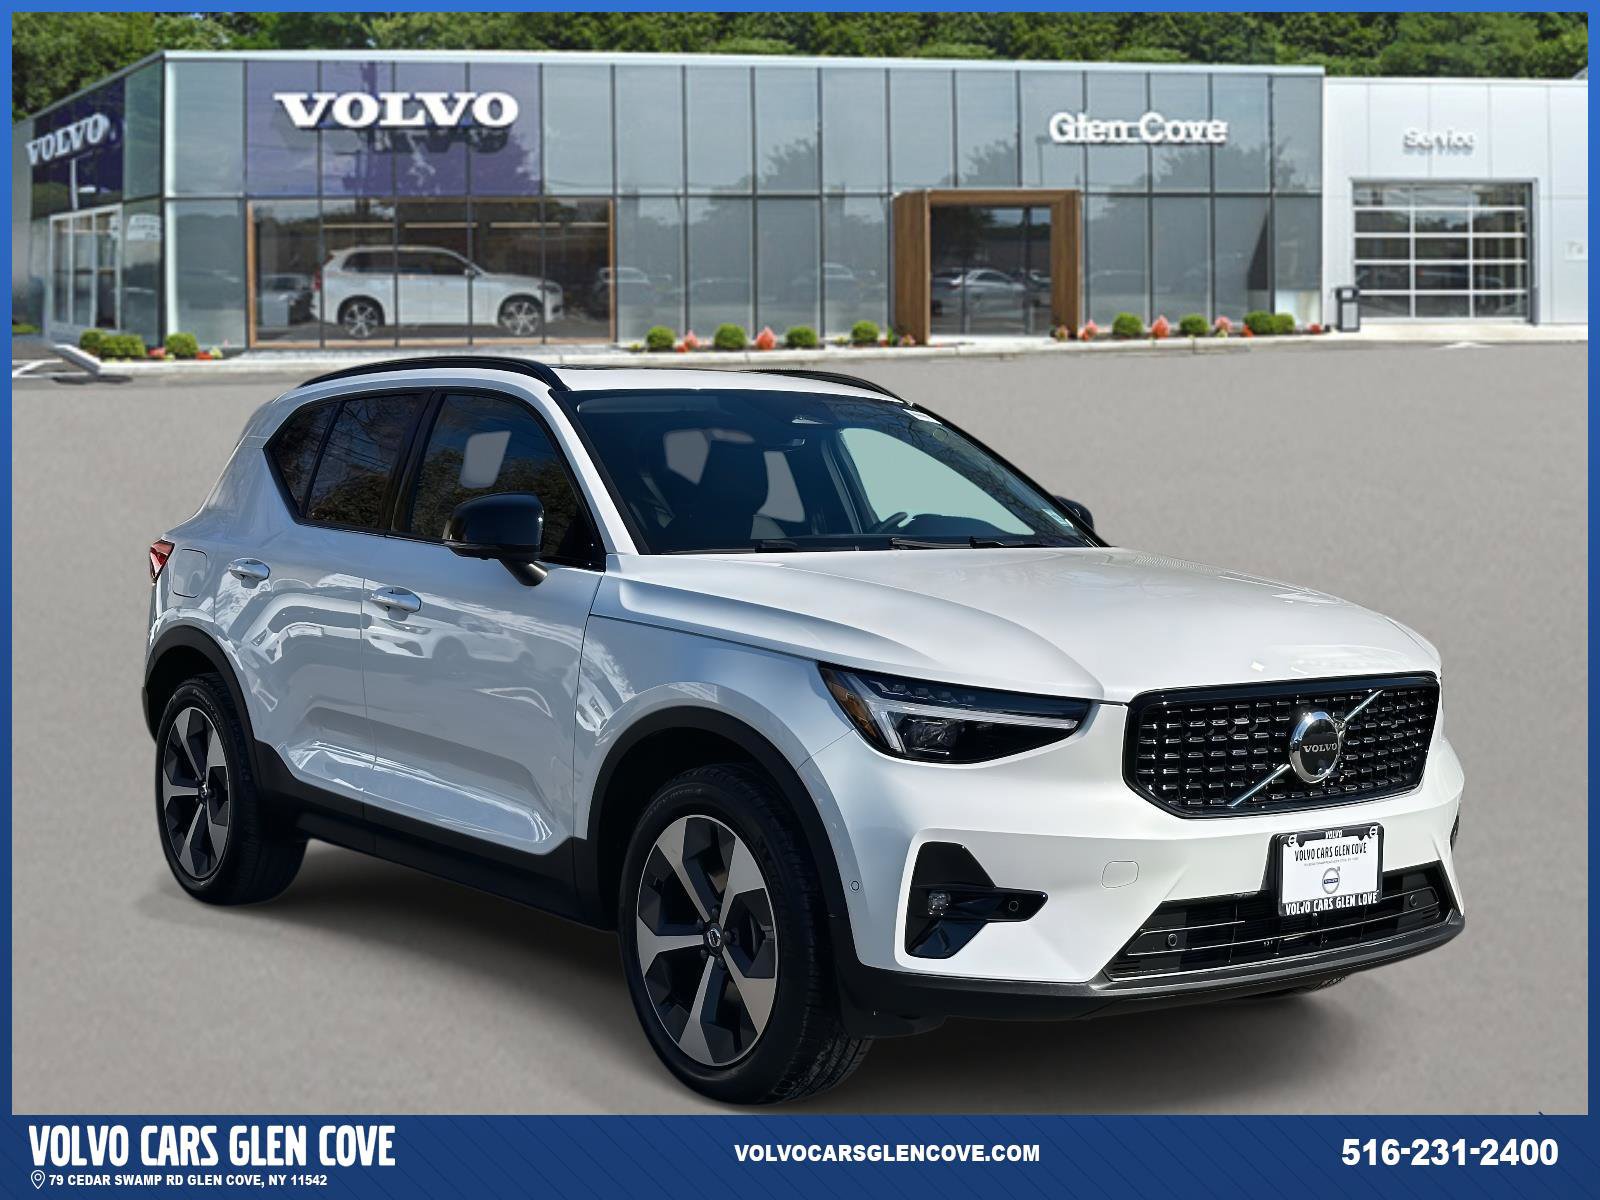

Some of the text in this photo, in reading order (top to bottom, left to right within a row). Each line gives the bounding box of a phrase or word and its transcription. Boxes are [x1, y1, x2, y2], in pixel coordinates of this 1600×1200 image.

[273, 91, 519, 128] VOLVO
[25, 112, 110, 166] VOLVO
[1049, 112, 1228, 144] Glen Cove
[1302, 743, 1338, 753] VOLVO
[1294, 848, 1316, 862] VOLVO
[1316, 846, 1333, 859] CARS
[1334, 844, 1351, 857] GLEN
[1351, 842, 1367, 855] COVE
[1285, 900, 1311, 916] VOLVO
[1313, 897, 1334, 912] CARS
[1335, 894, 1356, 909] GLEN
